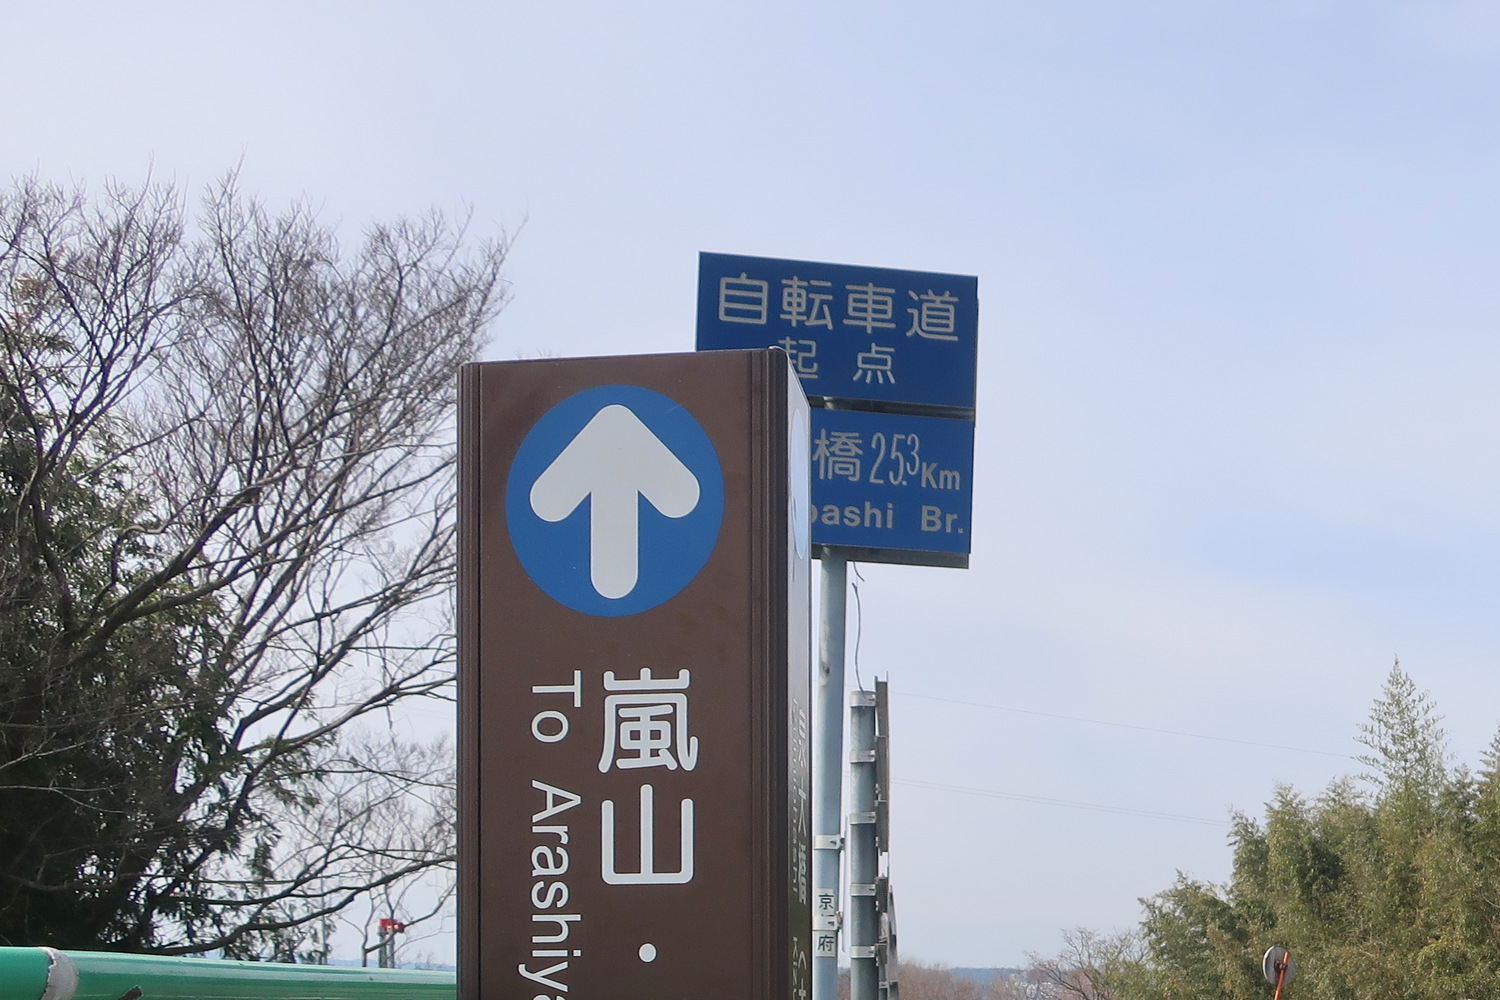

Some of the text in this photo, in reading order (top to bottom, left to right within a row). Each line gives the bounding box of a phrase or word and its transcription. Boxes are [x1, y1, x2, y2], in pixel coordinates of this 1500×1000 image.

[718, 272, 959, 342] 自転車道
[920, 504, 964, 534] Br.
[531, 669, 582, 744] To
[816, 892, 836, 953] 京府
